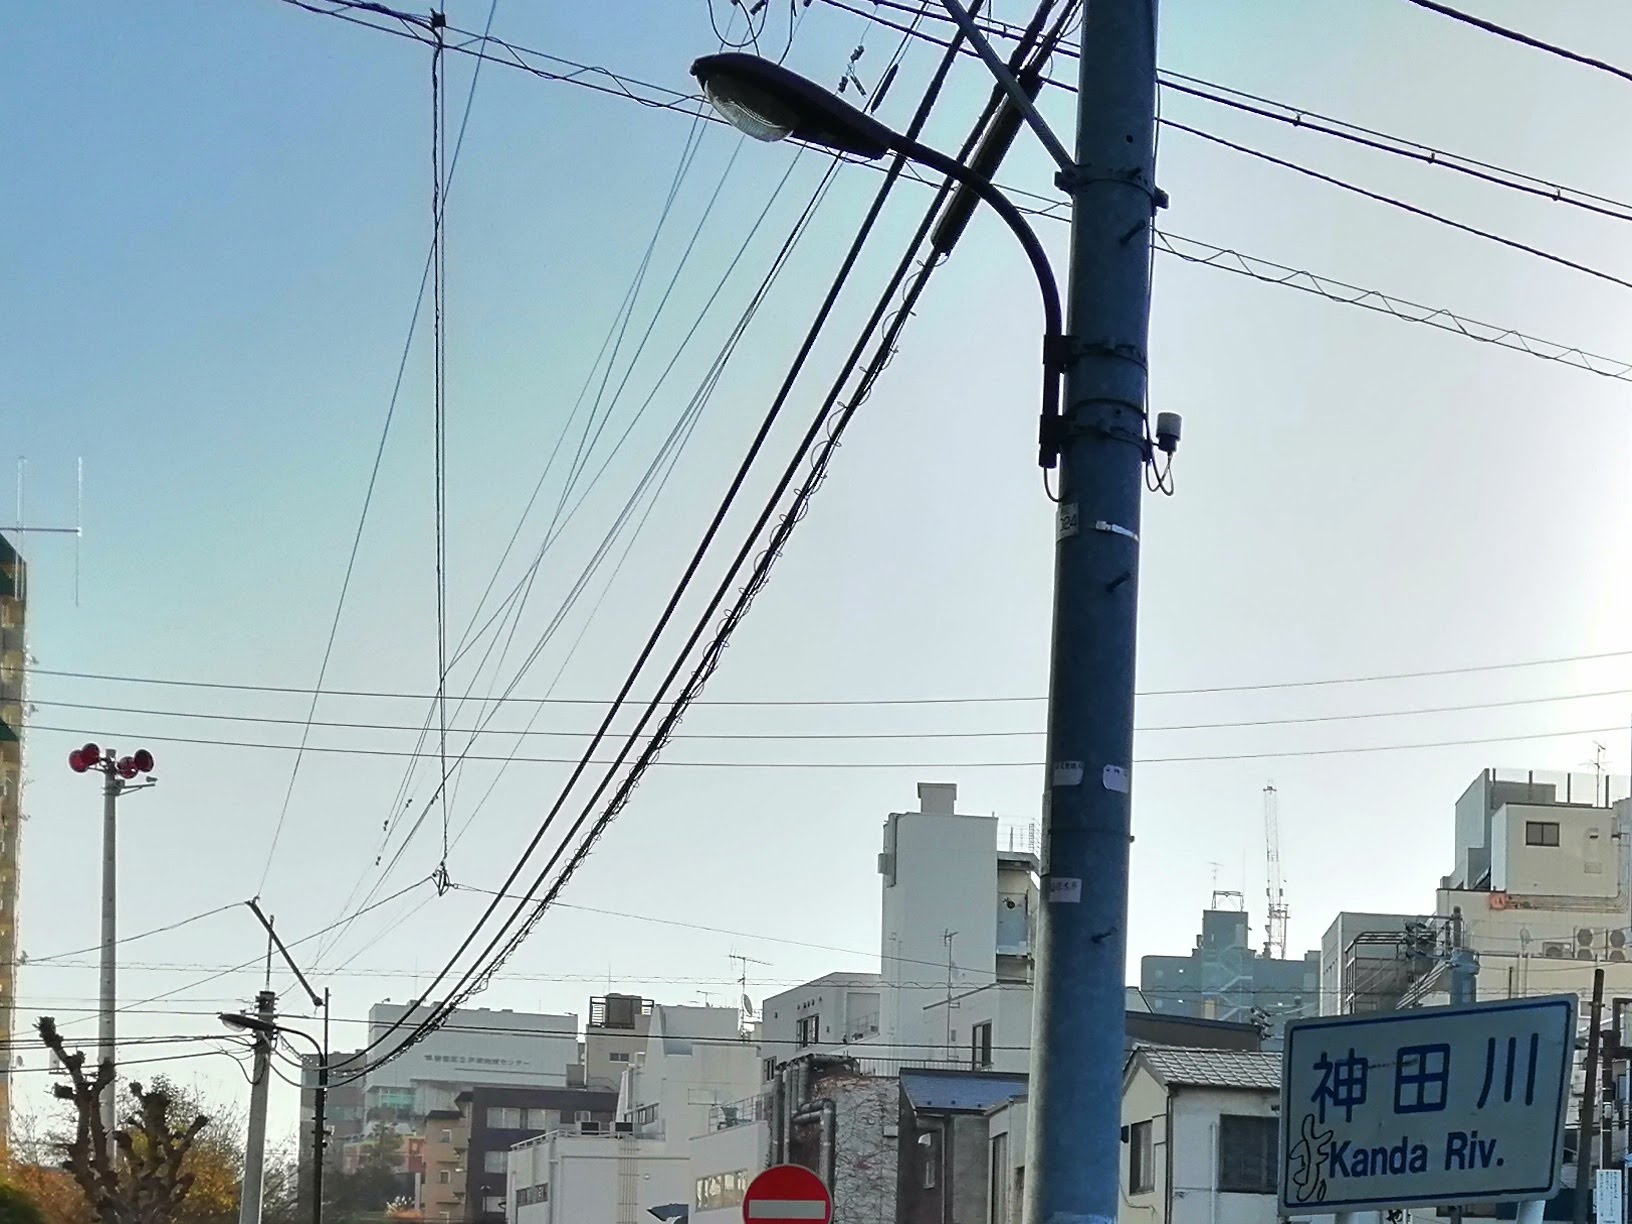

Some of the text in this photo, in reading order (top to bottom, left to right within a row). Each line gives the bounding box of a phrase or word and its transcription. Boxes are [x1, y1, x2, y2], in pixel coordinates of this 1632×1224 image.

[1311, 1032, 1539, 1124] 神田川
[1328, 1131, 1504, 1179] Kanda Riv.
